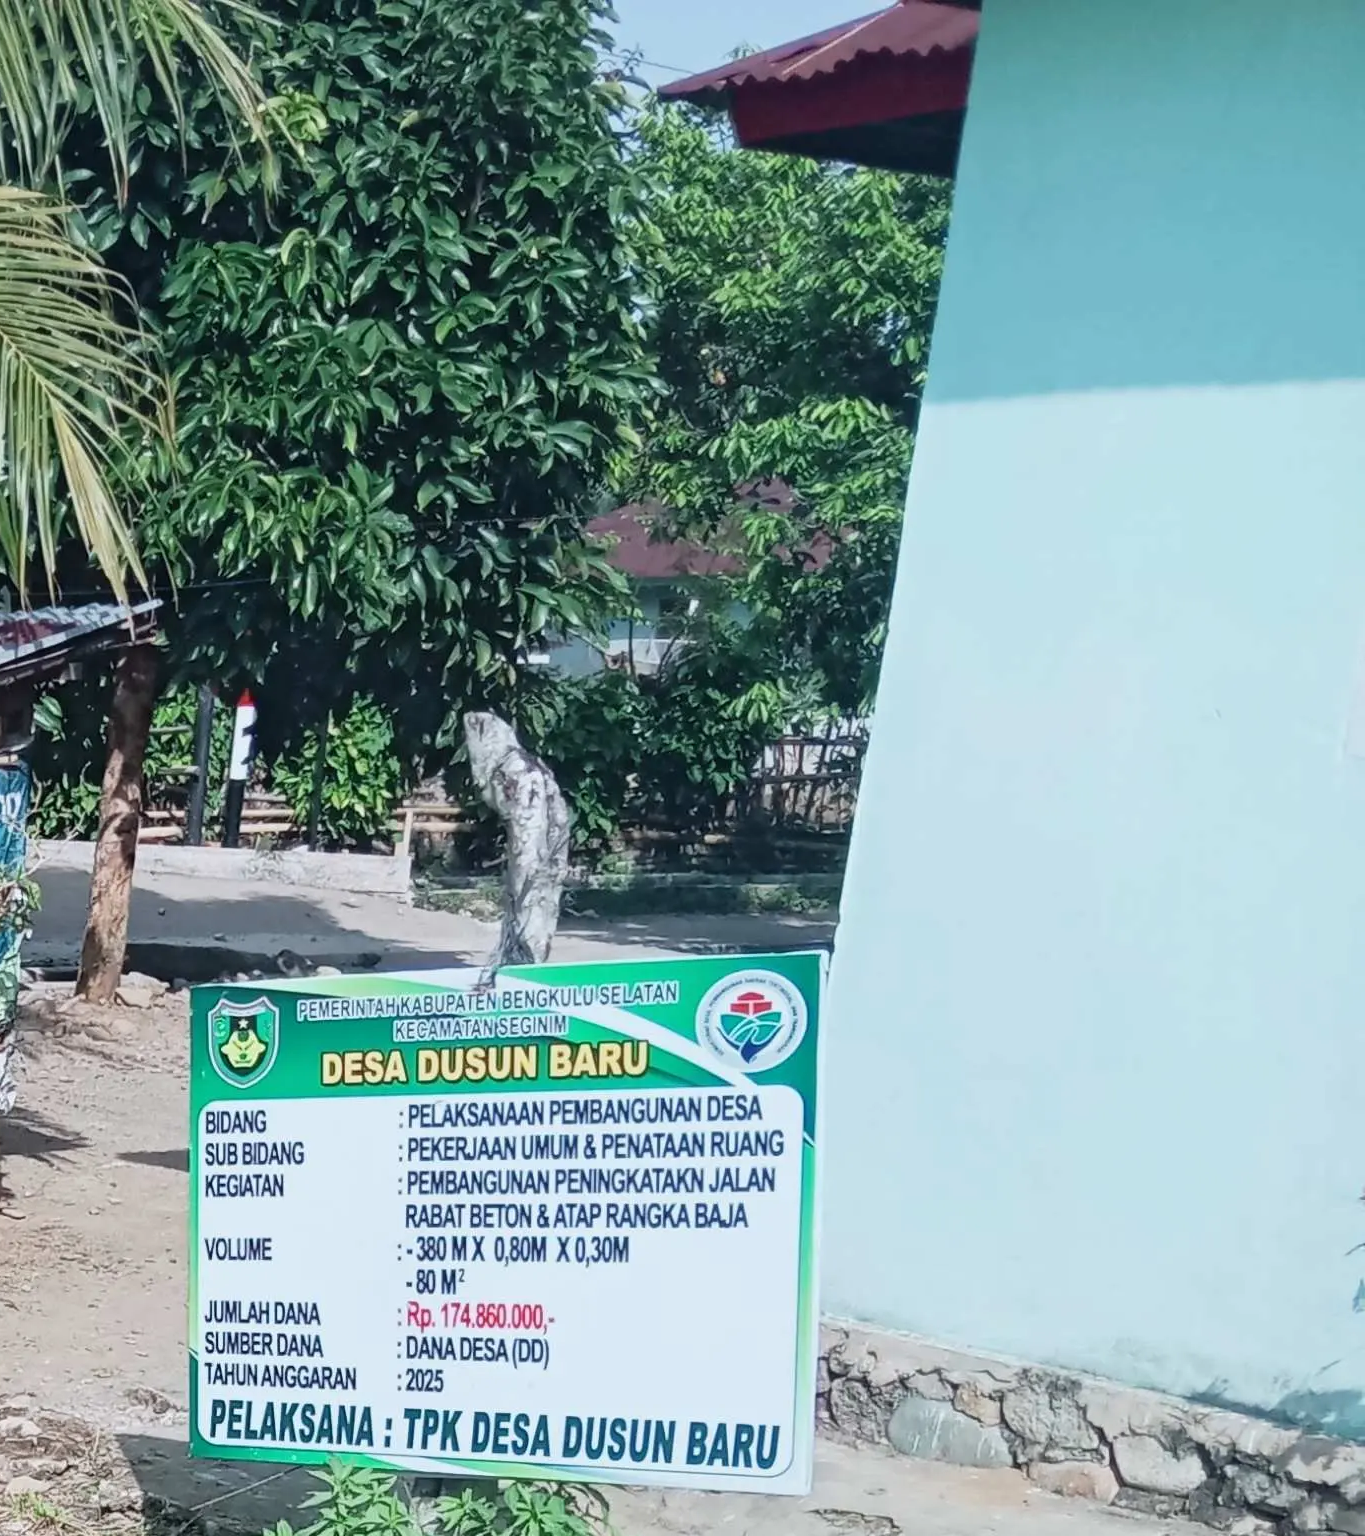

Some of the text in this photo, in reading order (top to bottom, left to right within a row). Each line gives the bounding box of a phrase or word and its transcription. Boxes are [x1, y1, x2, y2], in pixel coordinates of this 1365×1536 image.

[298, 983, 677, 1020] PEMERINTAH KABUPATEN BENGKULU SELATAN
[395, 1015, 567, 1040] KECAMATAN SEGINIM
[321, 1040, 650, 1085] DESA DUSUN BARU
[205, 1110, 267, 1134] BIDANG
[408, 1101, 544, 1128] PELAKSANAAN
[549, 1097, 702, 1125] PEMBANGUNAN
[706, 1094, 763, 1121] DESA
[205, 1142, 238, 1166] SUB
[242, 1141, 305, 1165] BIDANG
[407, 1136, 516, 1161] PEKERJAAN
[521, 1134, 579, 1160] UMUM
[583, 1133, 597, 1159] &
[601, 1132, 705, 1159] PENATAAN
[710, 1129, 785, 1157] RUANG
[204, 1174, 284, 1197] KEGIATAN
[407, 1169, 549, 1195] PEMBANGUNAN
[554, 1167, 704, 1194] PENINGKATAKN
[708, 1167, 776, 1192] JALAN
[405, 1202, 749, 1228] RABAT BETON & ATAP RANGKA BAJA
[204, 1237, 272, 1261] VOLUME
[416, 1236, 447, 1262] 380
[451, 1236, 467, 1261] M
[471, 1236, 485, 1262] X
[493, 1236, 547, 1267] 0,80M
[556, 1236, 570, 1262] X
[574, 1236, 630, 1268] 0,30M
[416, 1269, 436, 1294] 80
[204, 1300, 270, 1324] JUMLAH
[274, 1301, 321, 1325] DANA
[406, 1301, 435, 1333] Rp.
[440, 1302, 555, 1334] 174.860.000,-
[204, 1331, 273, 1356] SUMBER
[276, 1333, 324, 1358] DANA
[406, 1336, 456, 1360] DANA
[460, 1337, 509, 1362] DESA
[512, 1339, 550, 1370] (DD)
[204, 1362, 258, 1386] TAHUN
[261, 1365, 357, 1390] ANGGARAN
[405, 1368, 444, 1392] 2025
[209, 1398, 374, 1447] PELAKSANA
[403, 1407, 463, 1452] TPK
[471, 1411, 551, 1457] DESA
[562, 1415, 677, 1464] DUSUN
[686, 1421, 781, 1470] BARU
